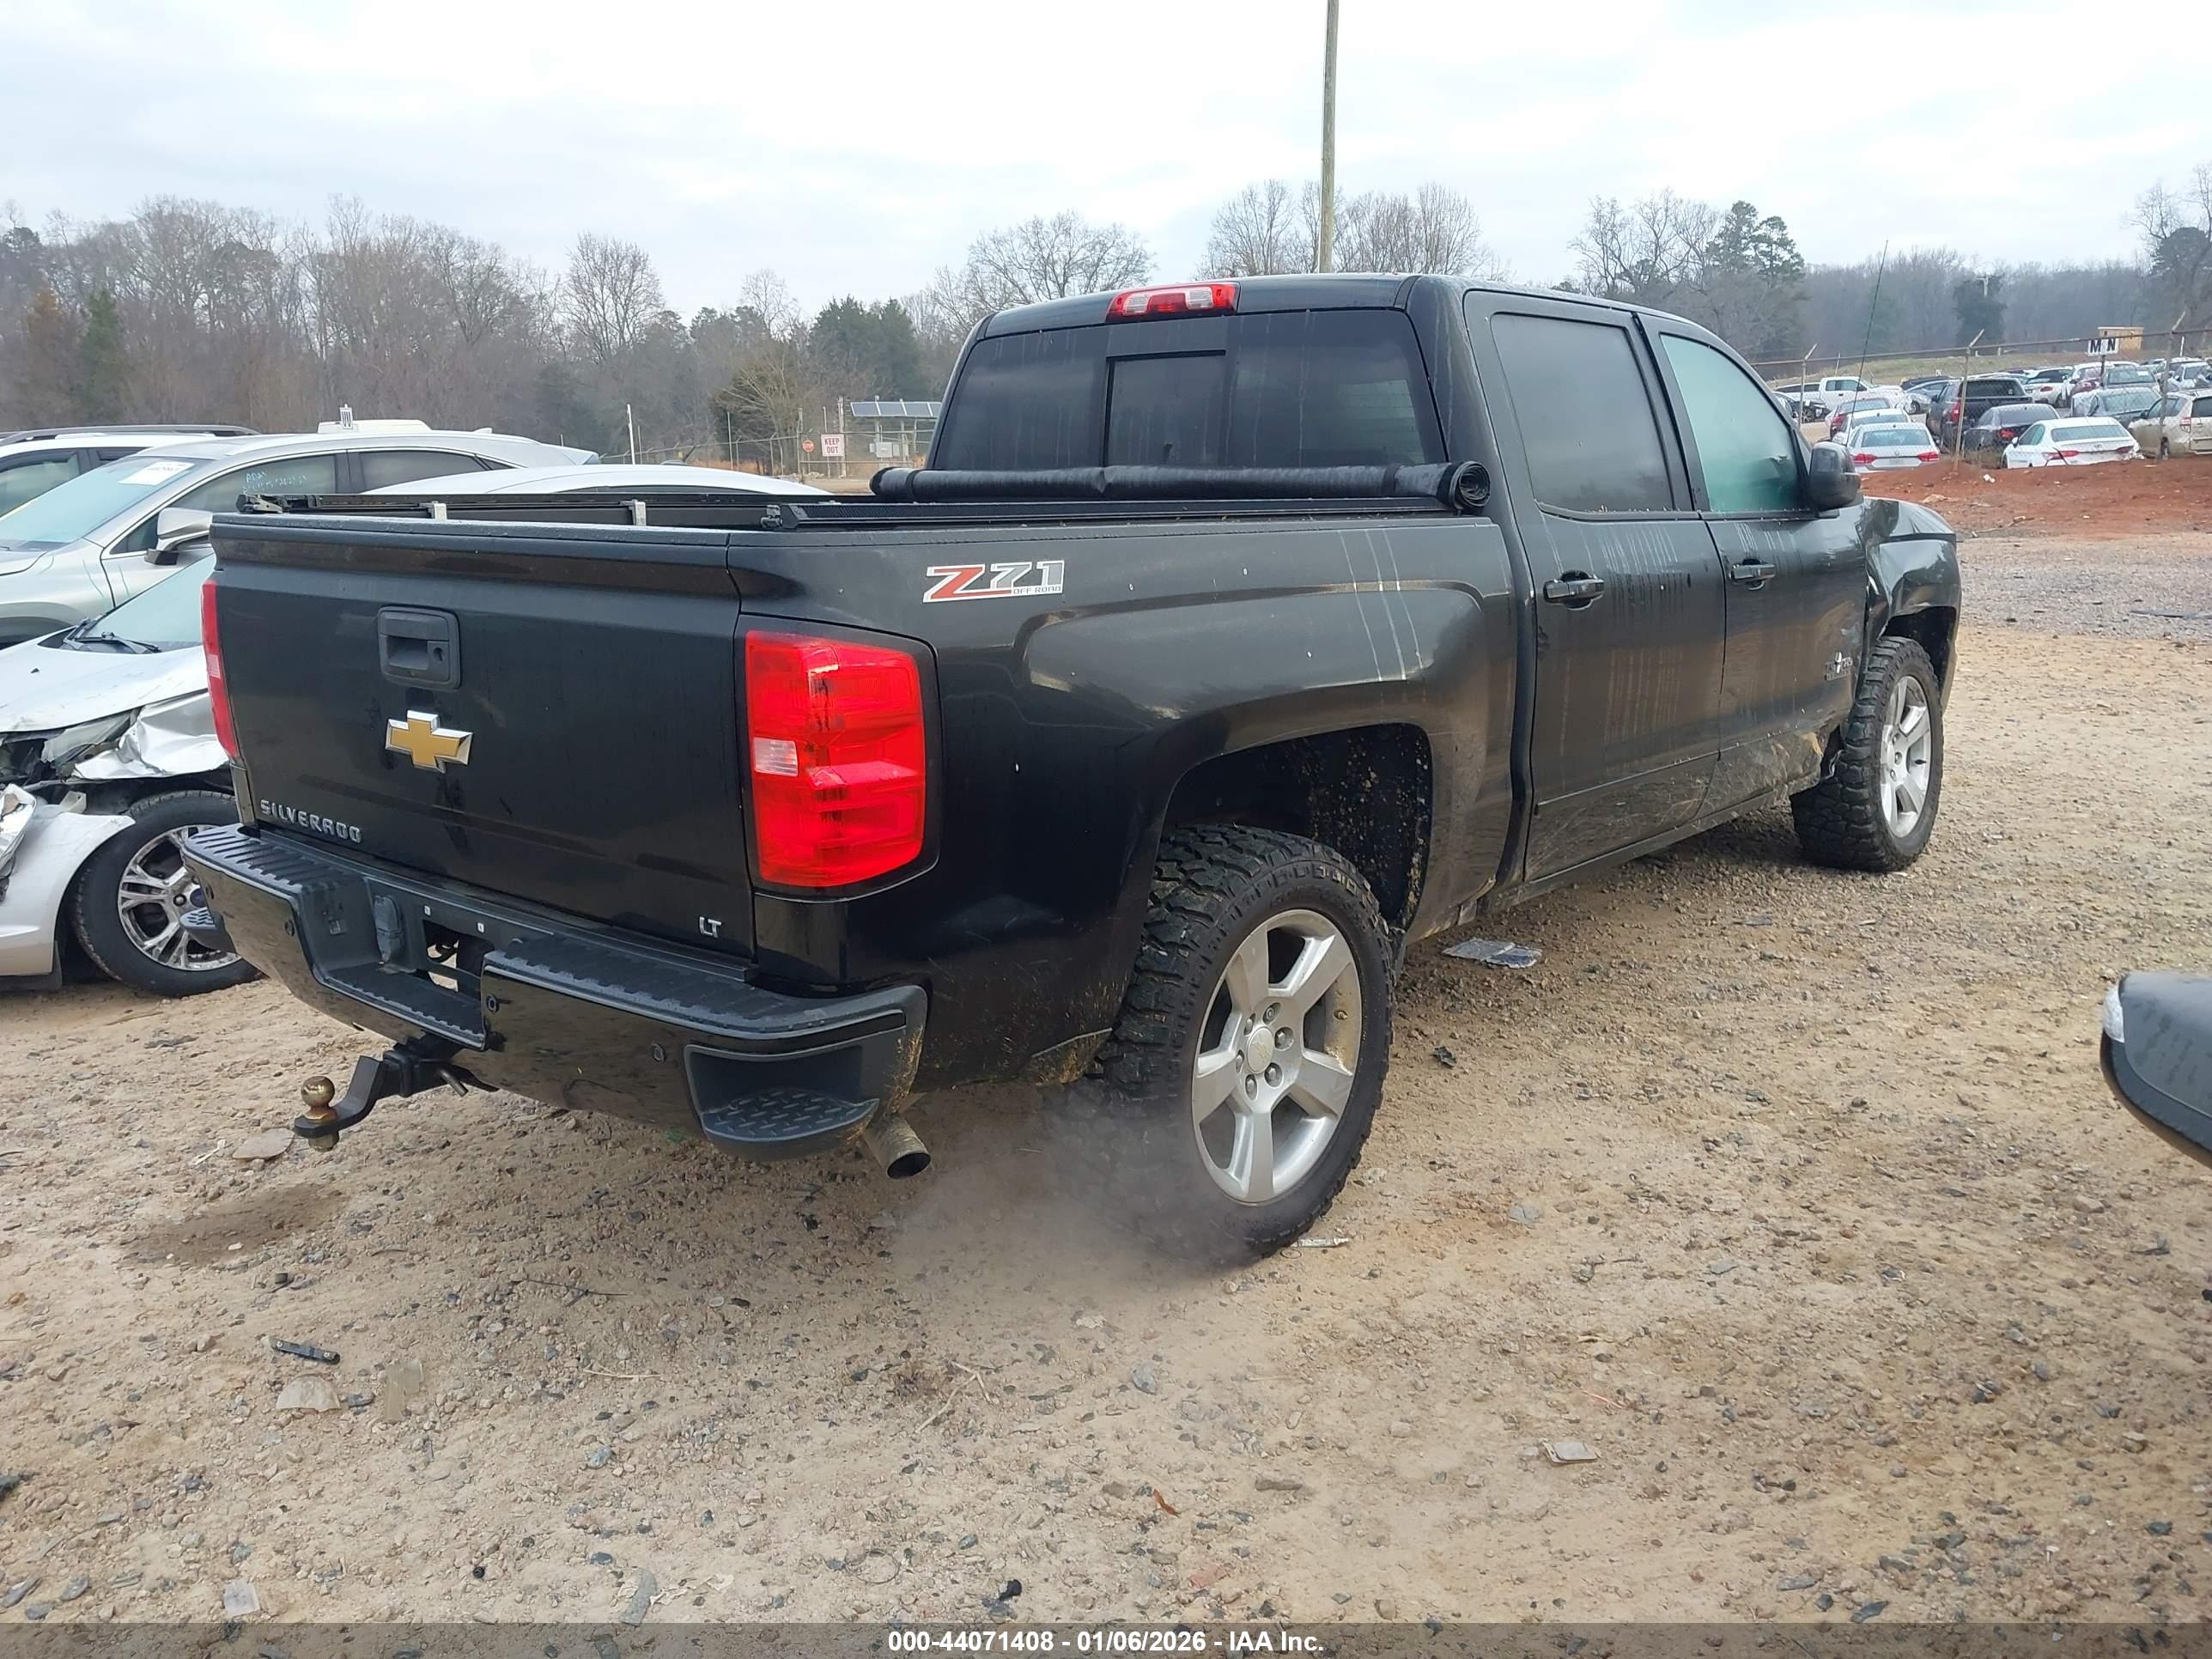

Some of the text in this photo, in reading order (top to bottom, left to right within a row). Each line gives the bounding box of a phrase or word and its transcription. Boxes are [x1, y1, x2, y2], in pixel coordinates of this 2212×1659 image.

[2089, 337, 2116, 354] M N
[826, 446, 839, 454] OUT
[923, 560, 1065, 603] Z71
[1035, 585, 1061, 593] ROAD
[260, 799, 362, 843] SILVERADO
[699, 915, 722, 939] LT
